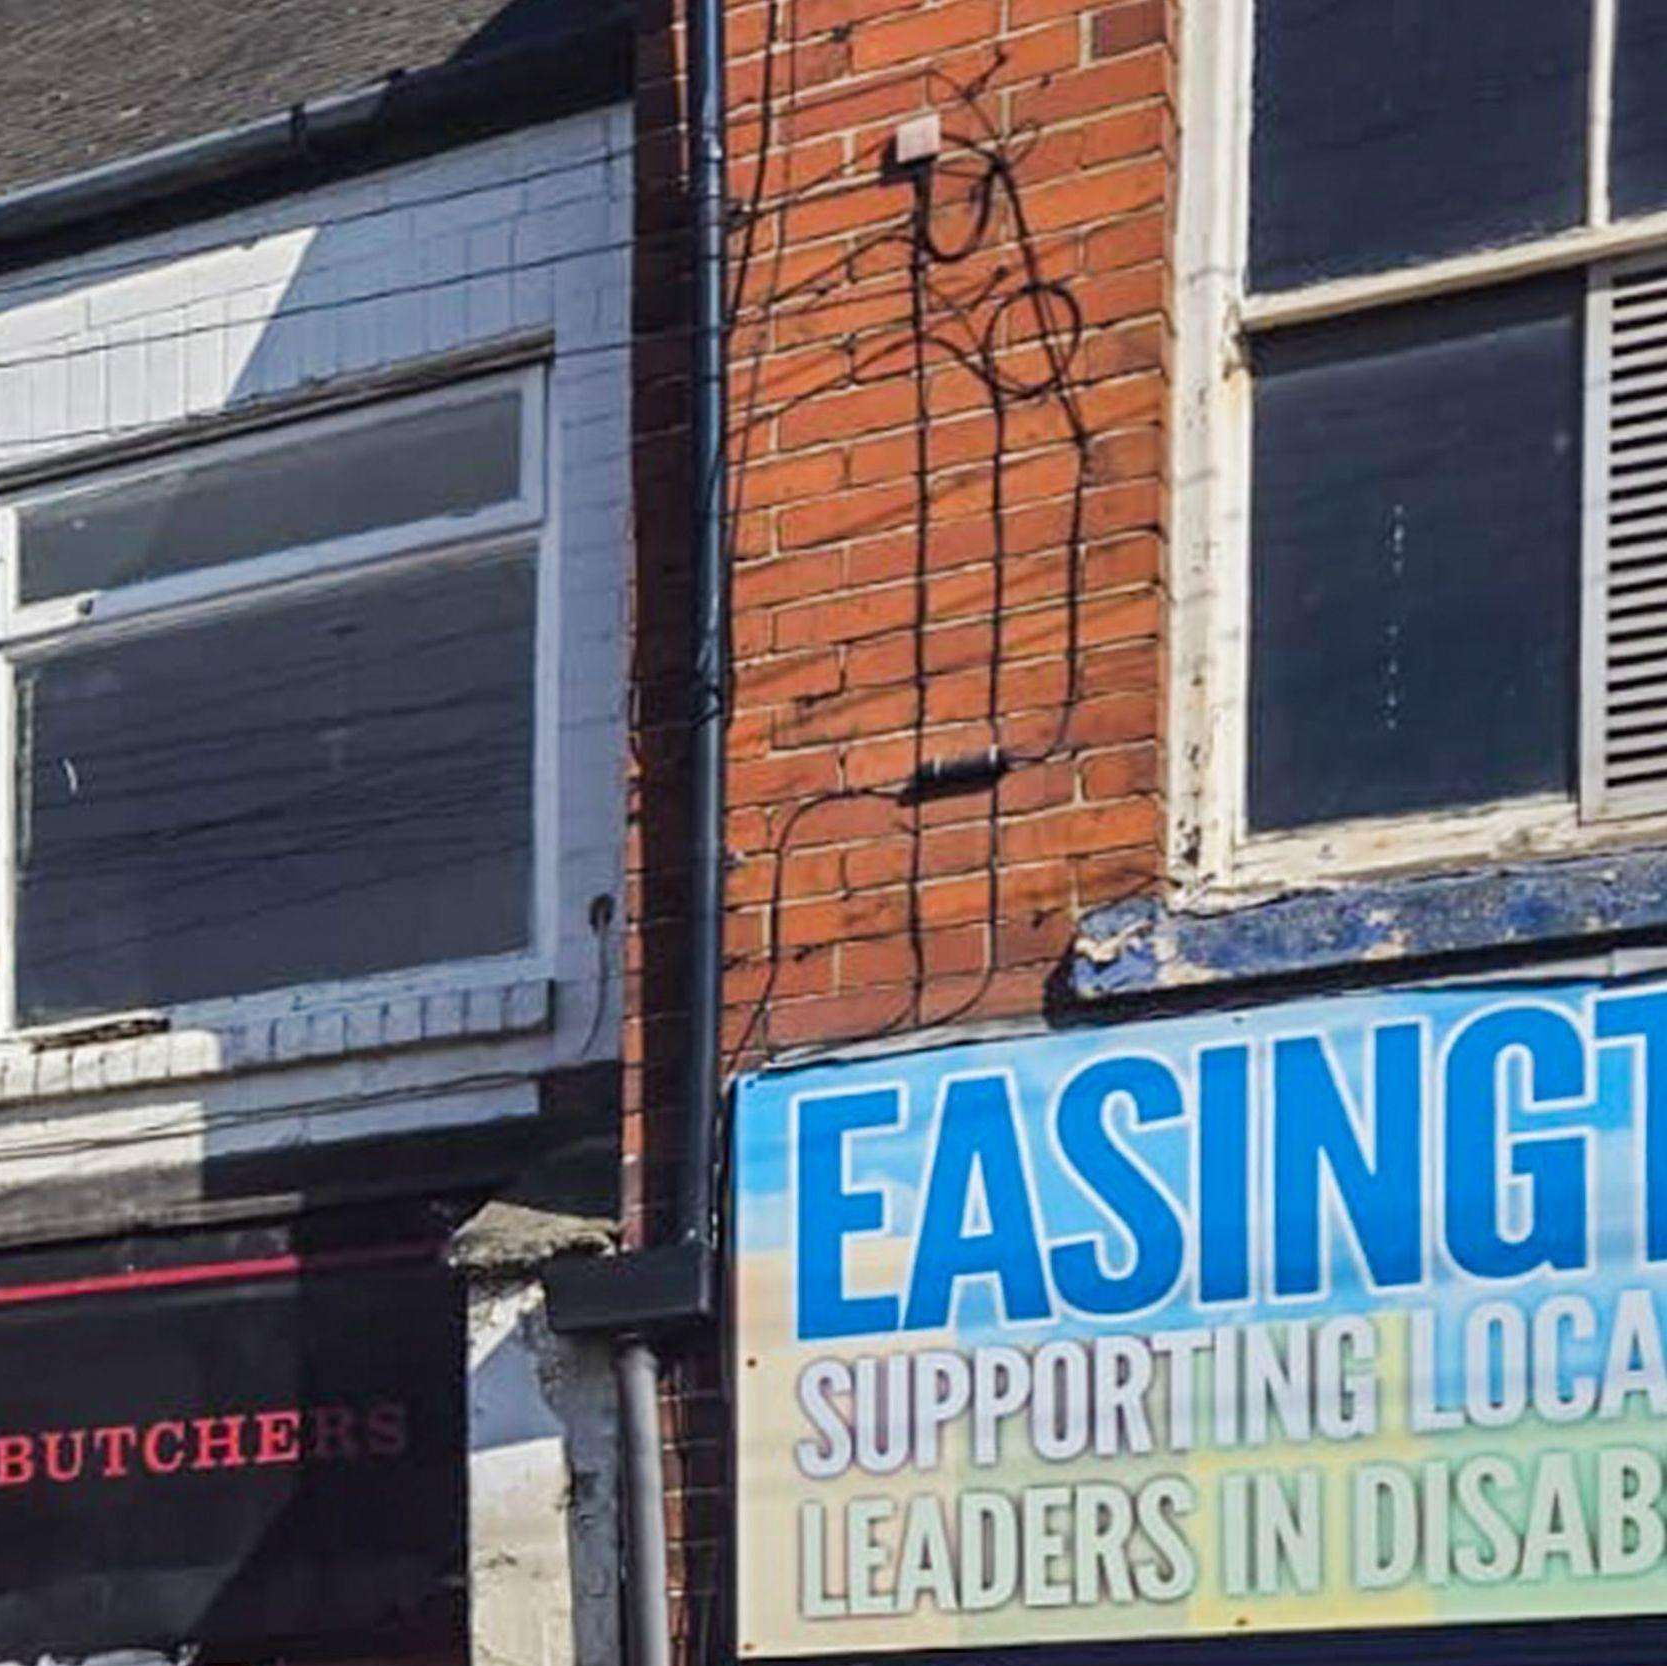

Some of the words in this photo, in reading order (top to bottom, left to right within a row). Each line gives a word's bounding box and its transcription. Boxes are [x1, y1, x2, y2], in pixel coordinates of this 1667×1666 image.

[796, 1318, 1378, 1480] SUPPORTING
[1410, 1288, 1667, 1435] LOCA
[799, 1474, 1197, 1619] LEADERS
[1221, 1466, 1322, 1596] IN
[1355, 1448, 1667, 1589] DISAB
